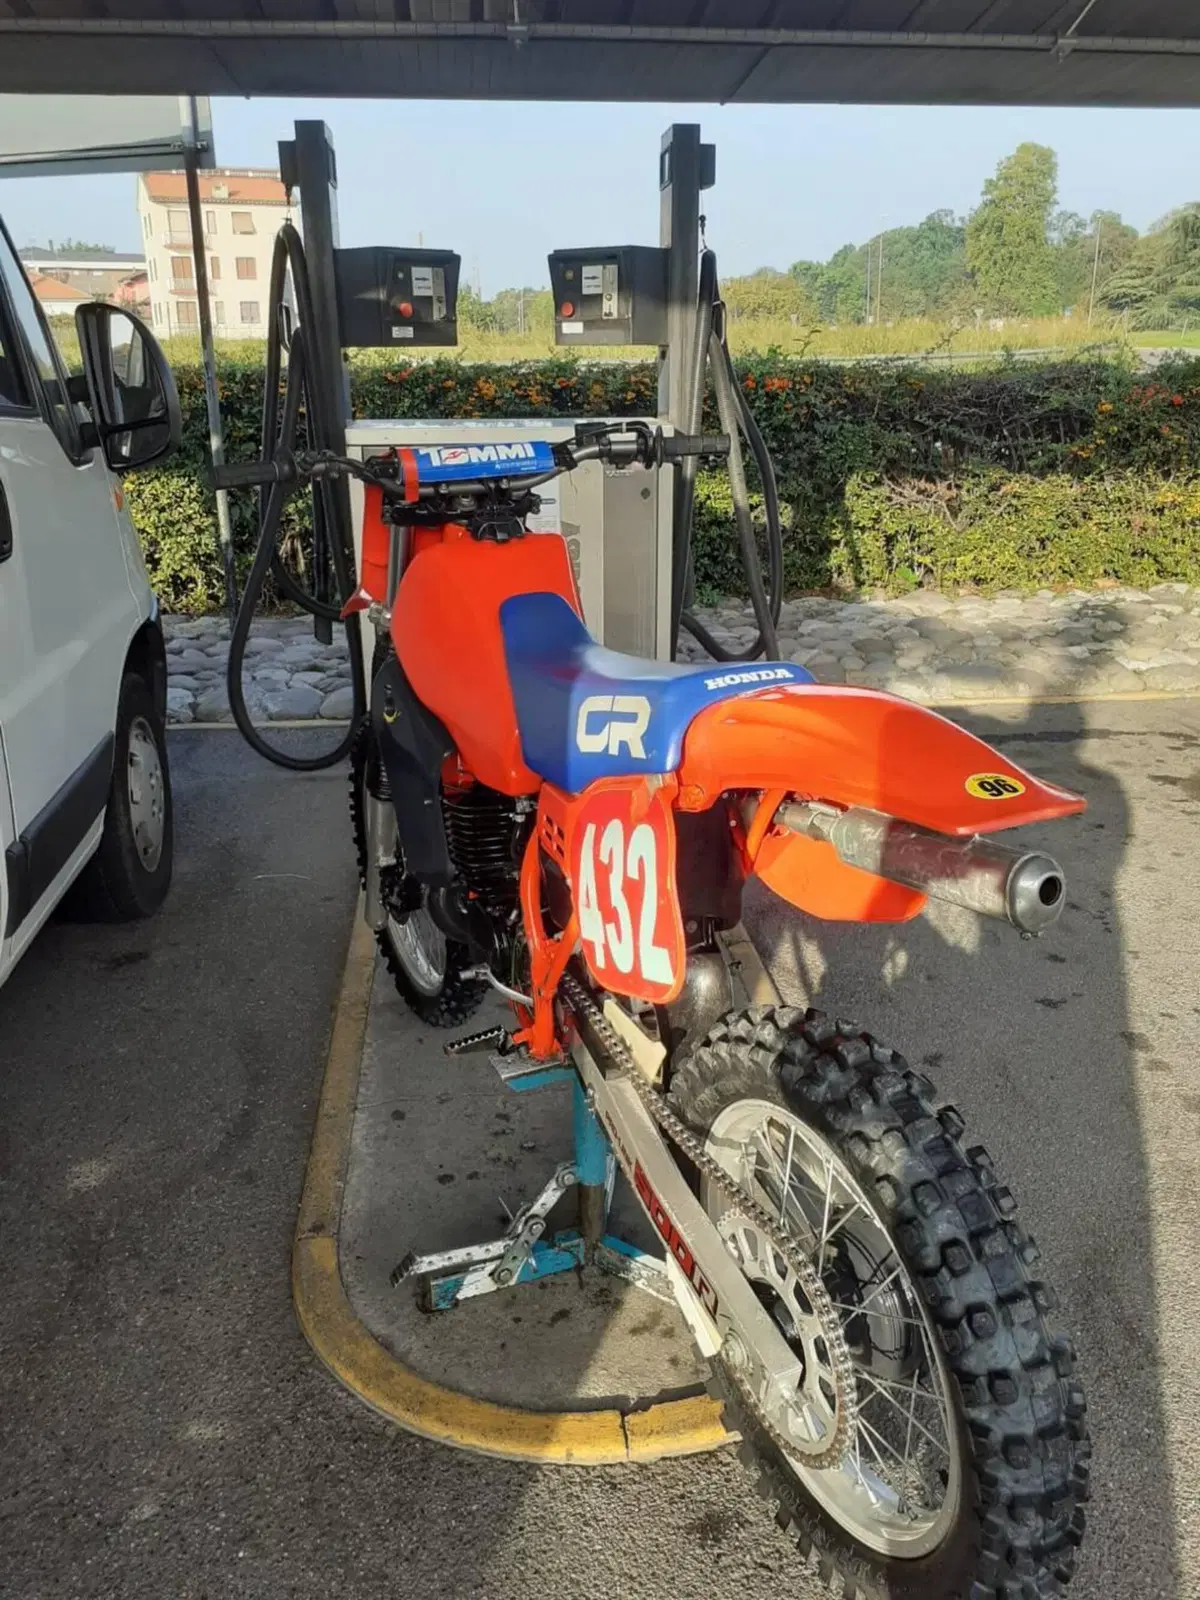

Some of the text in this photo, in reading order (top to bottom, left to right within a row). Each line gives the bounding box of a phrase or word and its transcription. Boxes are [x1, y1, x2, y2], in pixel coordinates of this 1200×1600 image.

[418, 443, 536, 467] TOMMI
[703, 668, 794, 690] HONDA
[576, 695, 651, 760] CR
[977, 778, 1020, 797] 96
[578, 818, 675, 986] 432
